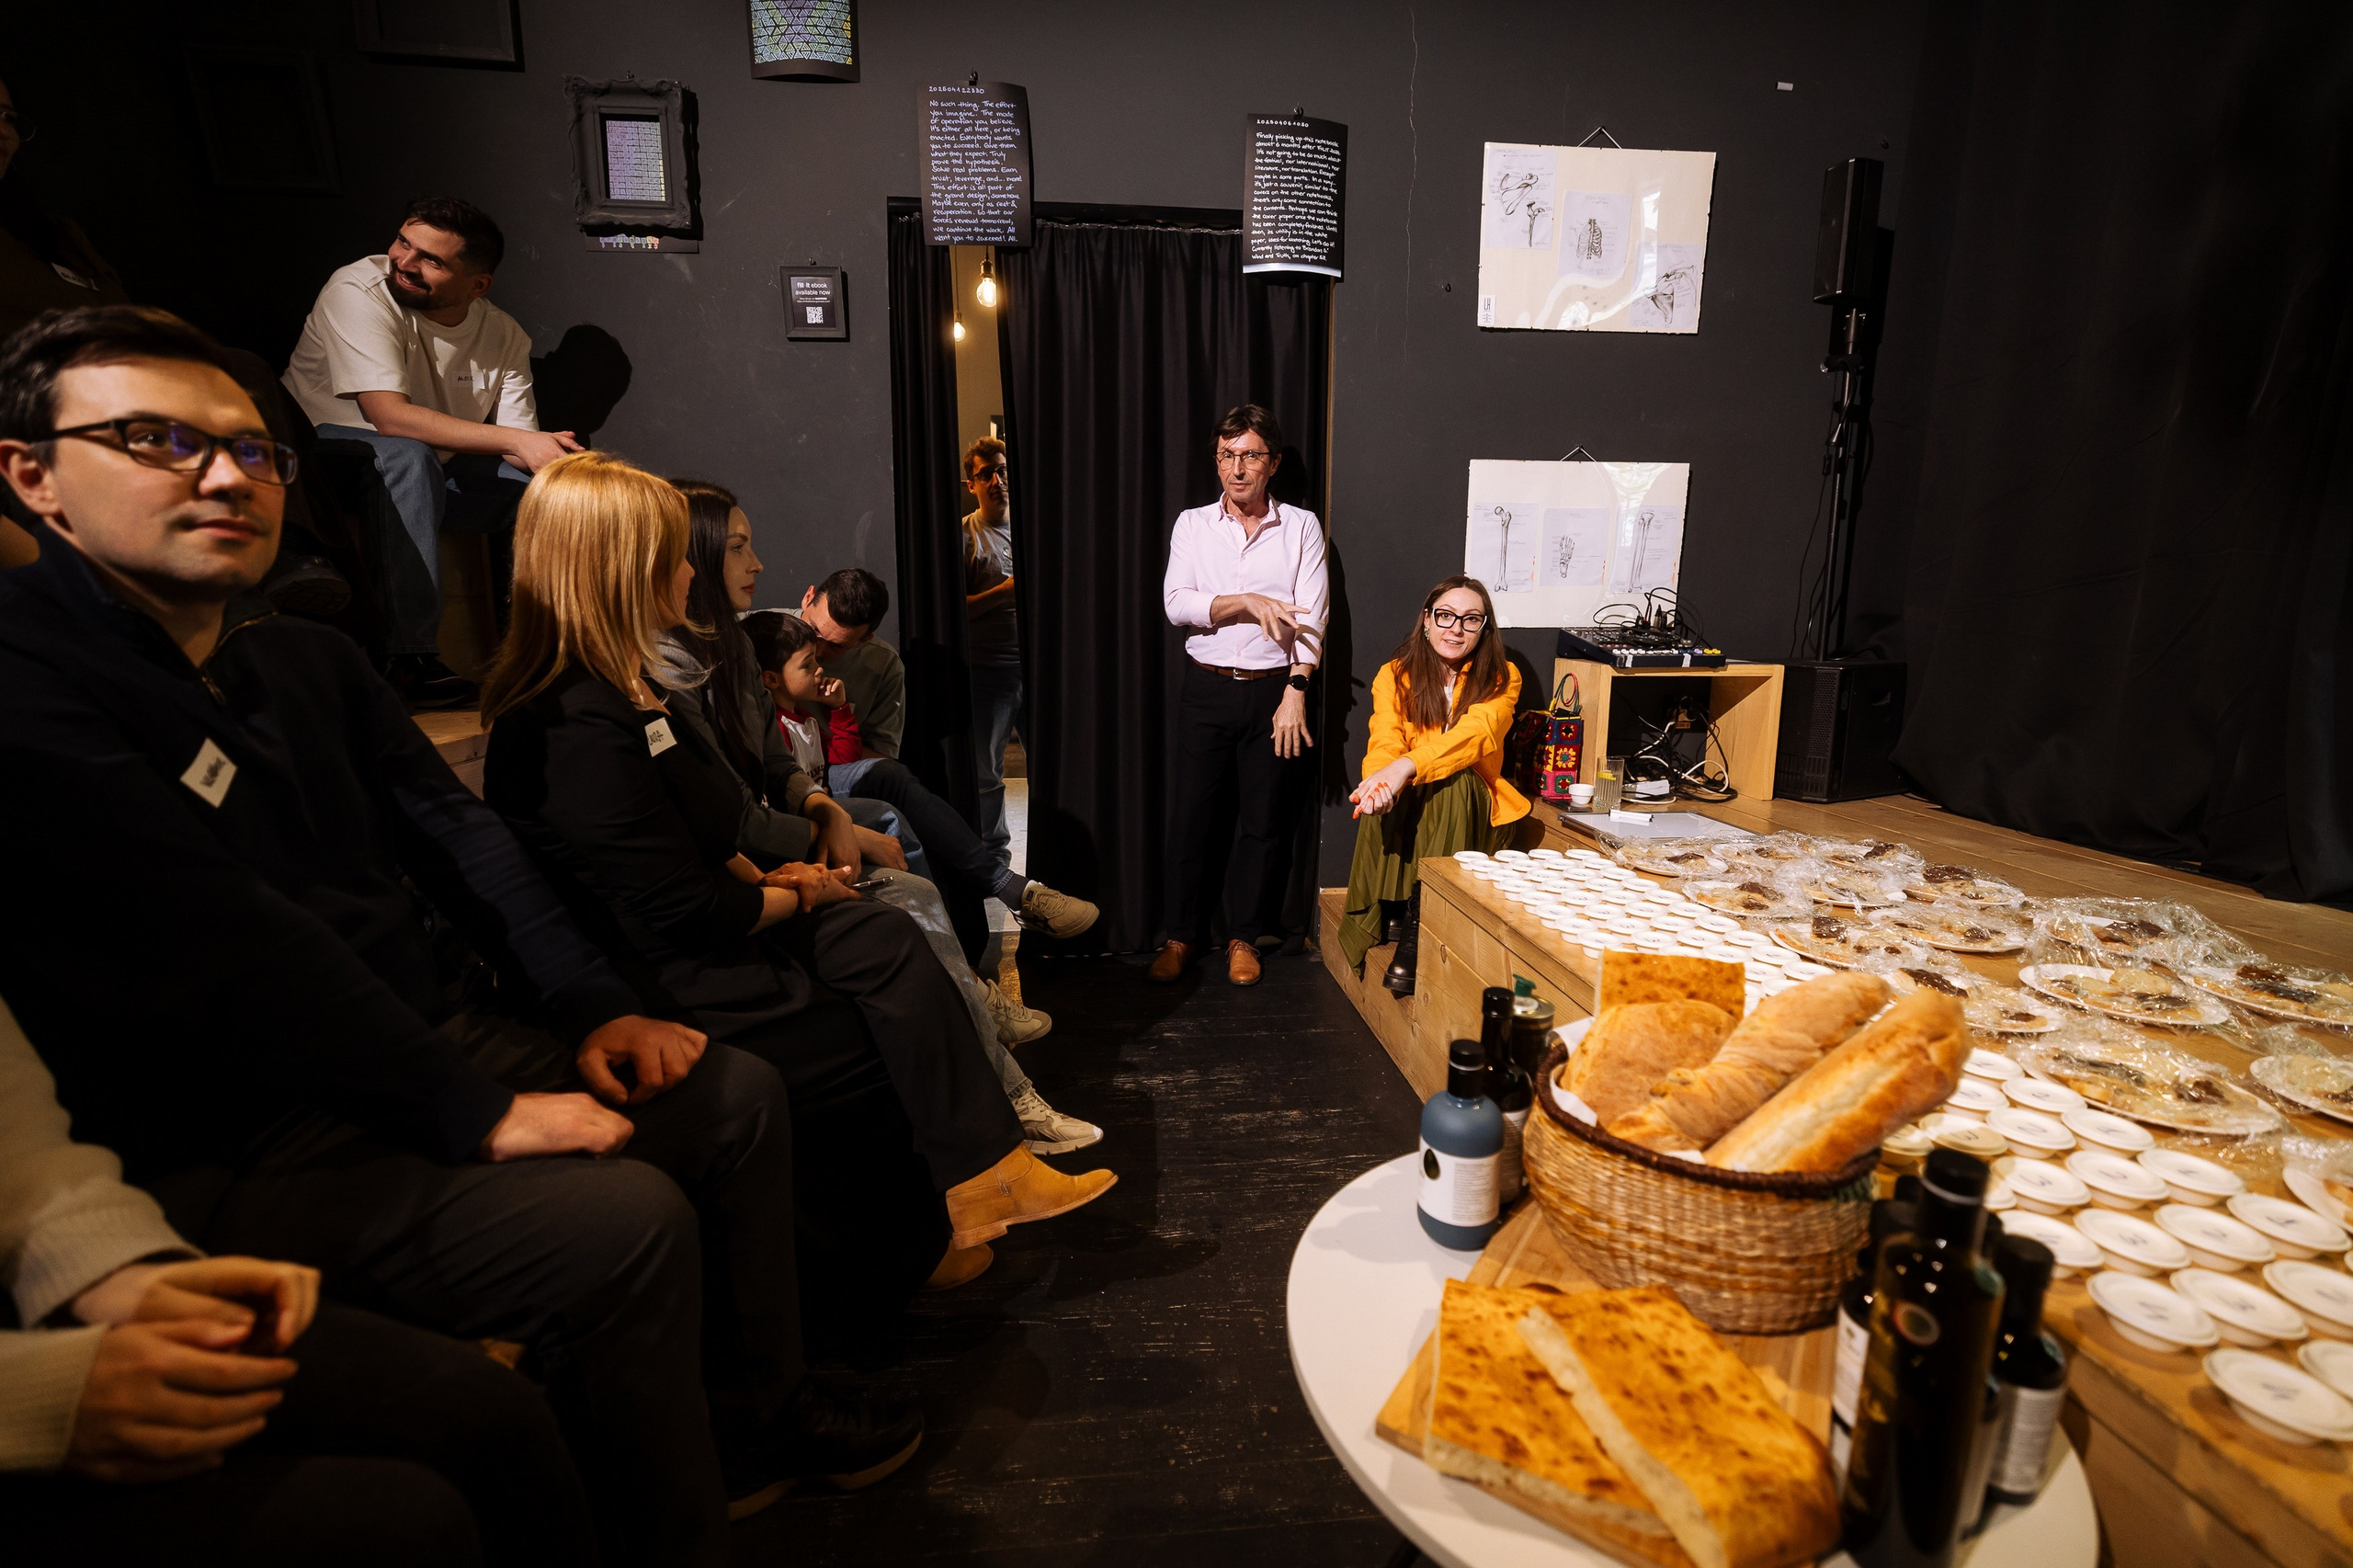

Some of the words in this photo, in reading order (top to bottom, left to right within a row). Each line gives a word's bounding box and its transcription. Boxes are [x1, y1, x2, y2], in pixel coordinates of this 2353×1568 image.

[958, 102, 980, 111] thing.
[930, 110, 943, 119] you
[946, 109, 977, 119] imagine.
[941, 118, 972, 127] operation
[974, 120, 988, 129] you
[975, 126, 992, 134] here,
[1003, 127, 1020, 136] being
[960, 133, 991, 144] Everybody
[949, 152, 962, 161] they
[990, 151, 1006, 161] Truly
[969, 167, 999, 176] problems.
[955, 176, 985, 185] leverage,
[987, 184, 1003, 194] part
[945, 192, 964, 201] grand
[967, 192, 990, 201] design,
[932, 199, 951, 210] Maybe
[972, 201, 983, 210] only
[933, 209, 975, 219] recuperation.
[952, 235, 964, 244] you
